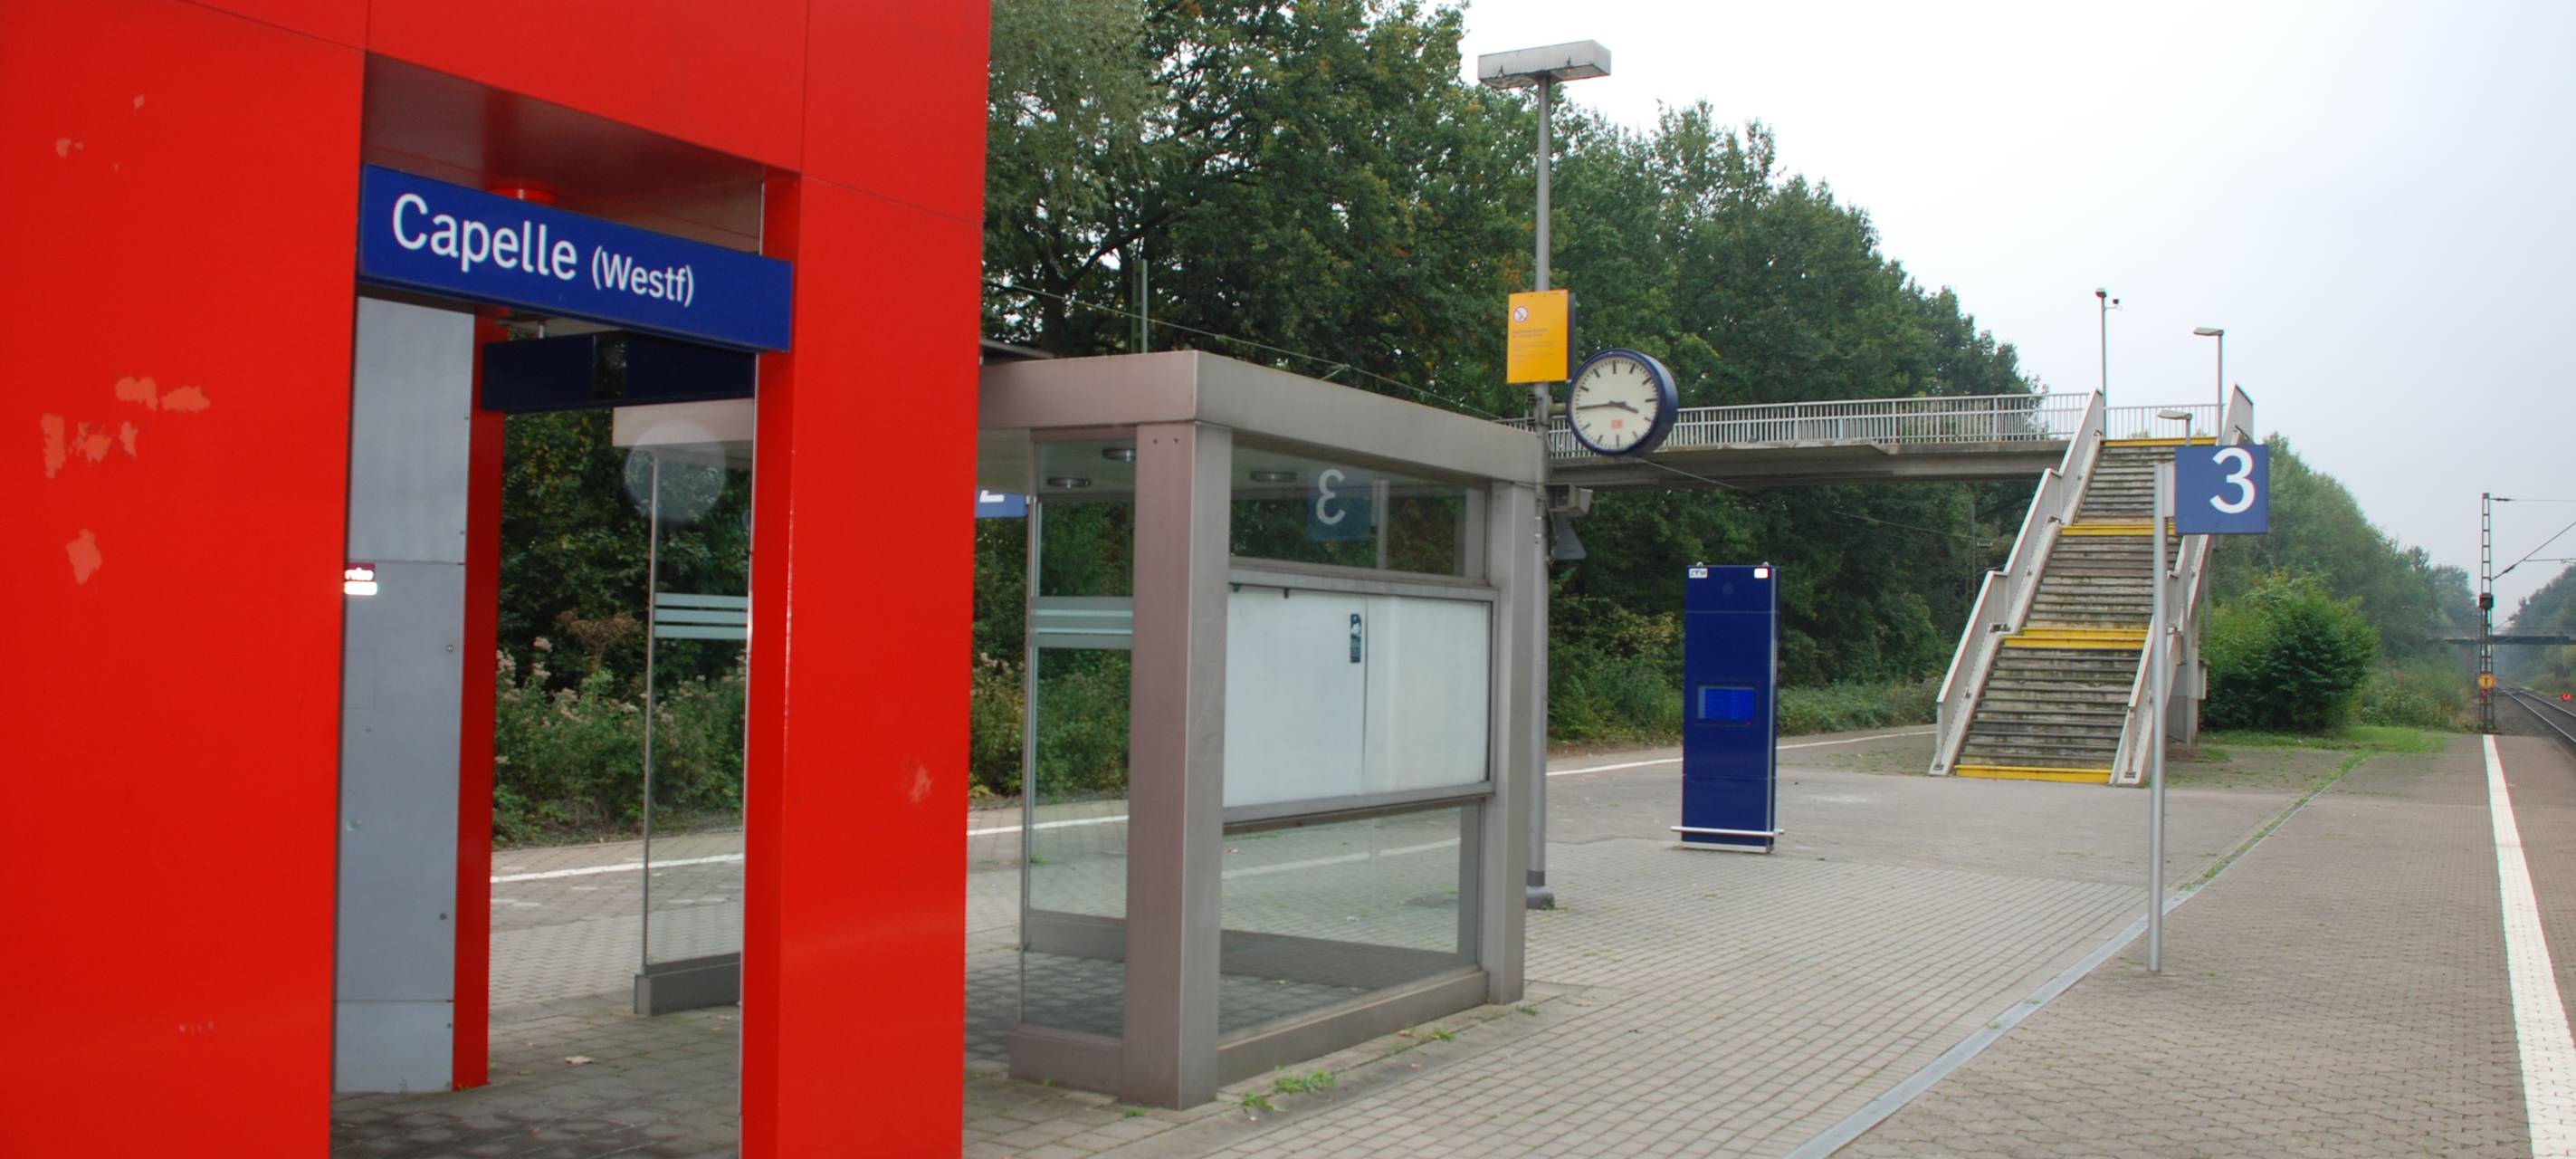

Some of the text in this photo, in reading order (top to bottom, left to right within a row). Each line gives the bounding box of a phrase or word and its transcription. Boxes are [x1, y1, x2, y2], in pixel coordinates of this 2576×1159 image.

[392, 194, 694, 307] Capelle (Westf)
[2209, 447, 2256, 514] 3
